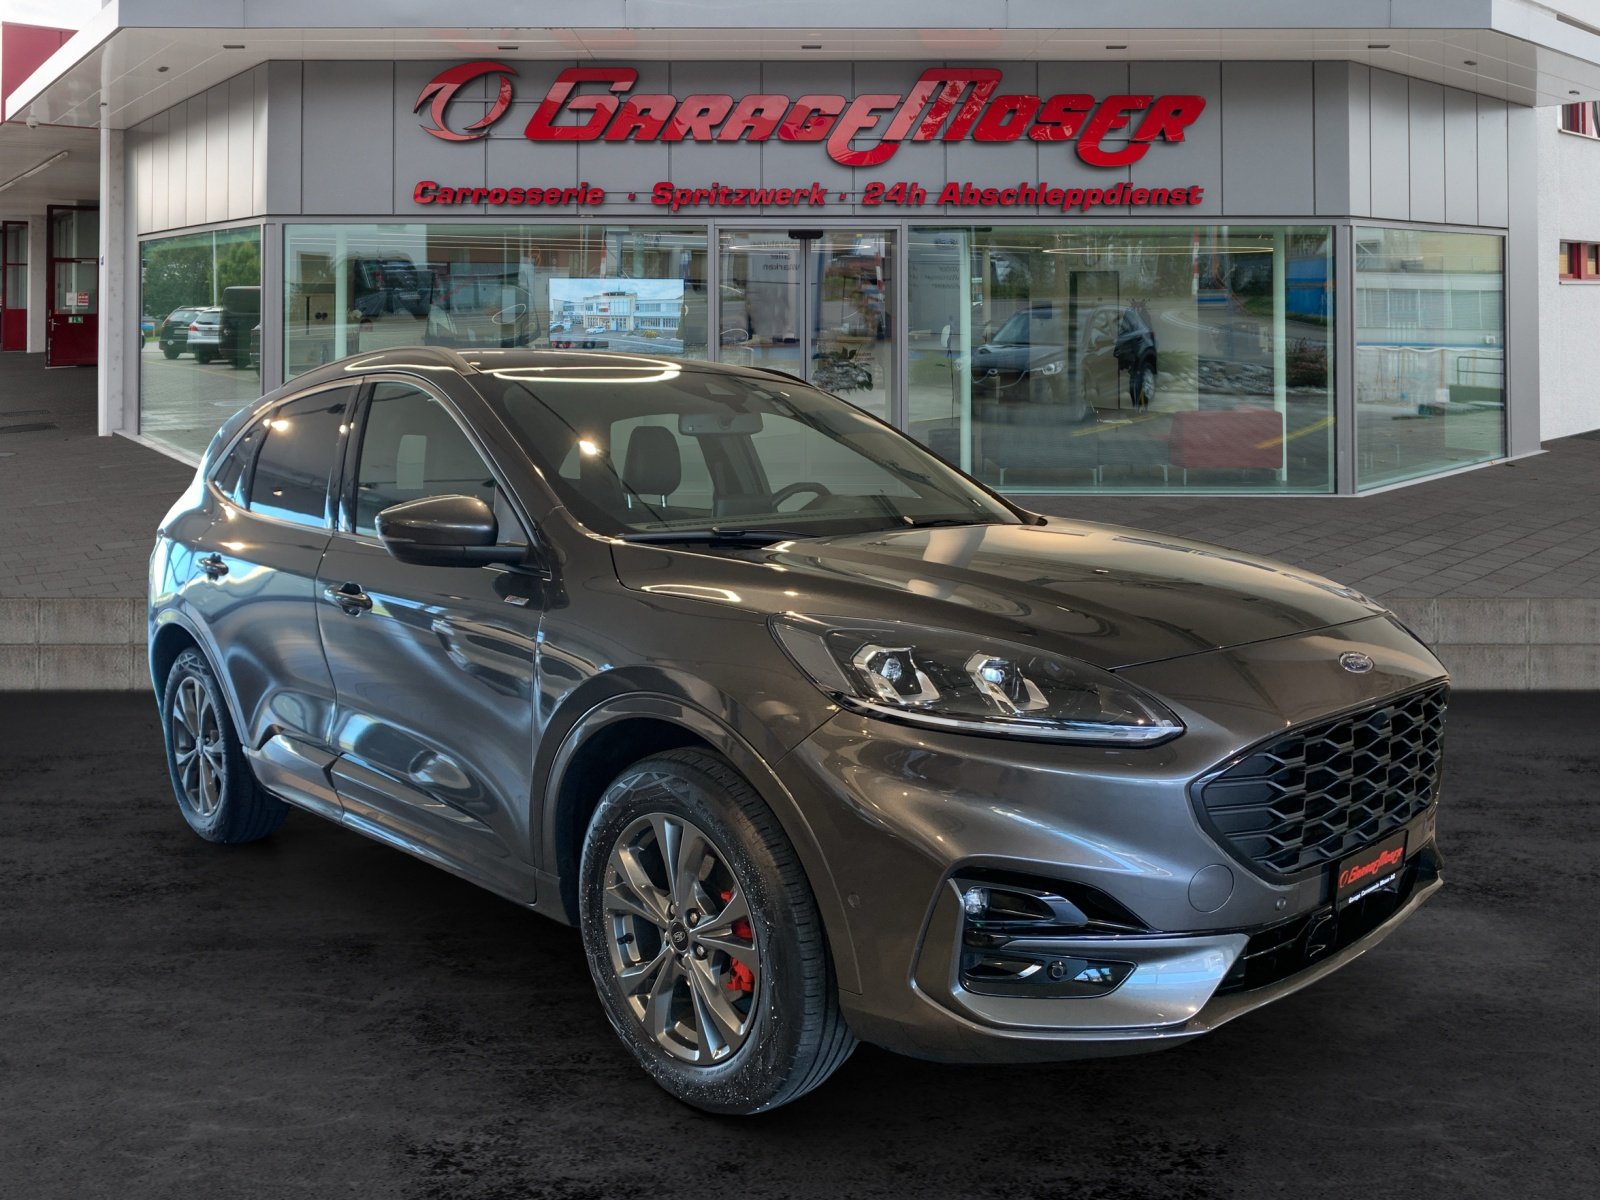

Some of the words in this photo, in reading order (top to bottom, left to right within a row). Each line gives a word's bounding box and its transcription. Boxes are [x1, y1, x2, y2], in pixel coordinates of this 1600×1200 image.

[412, 181, 604, 206] Carrosserie
[651, 182, 826, 211] Spritzwerk
[862, 182, 926, 206] 24h
[937, 182, 1204, 212] Abschleppdienst
